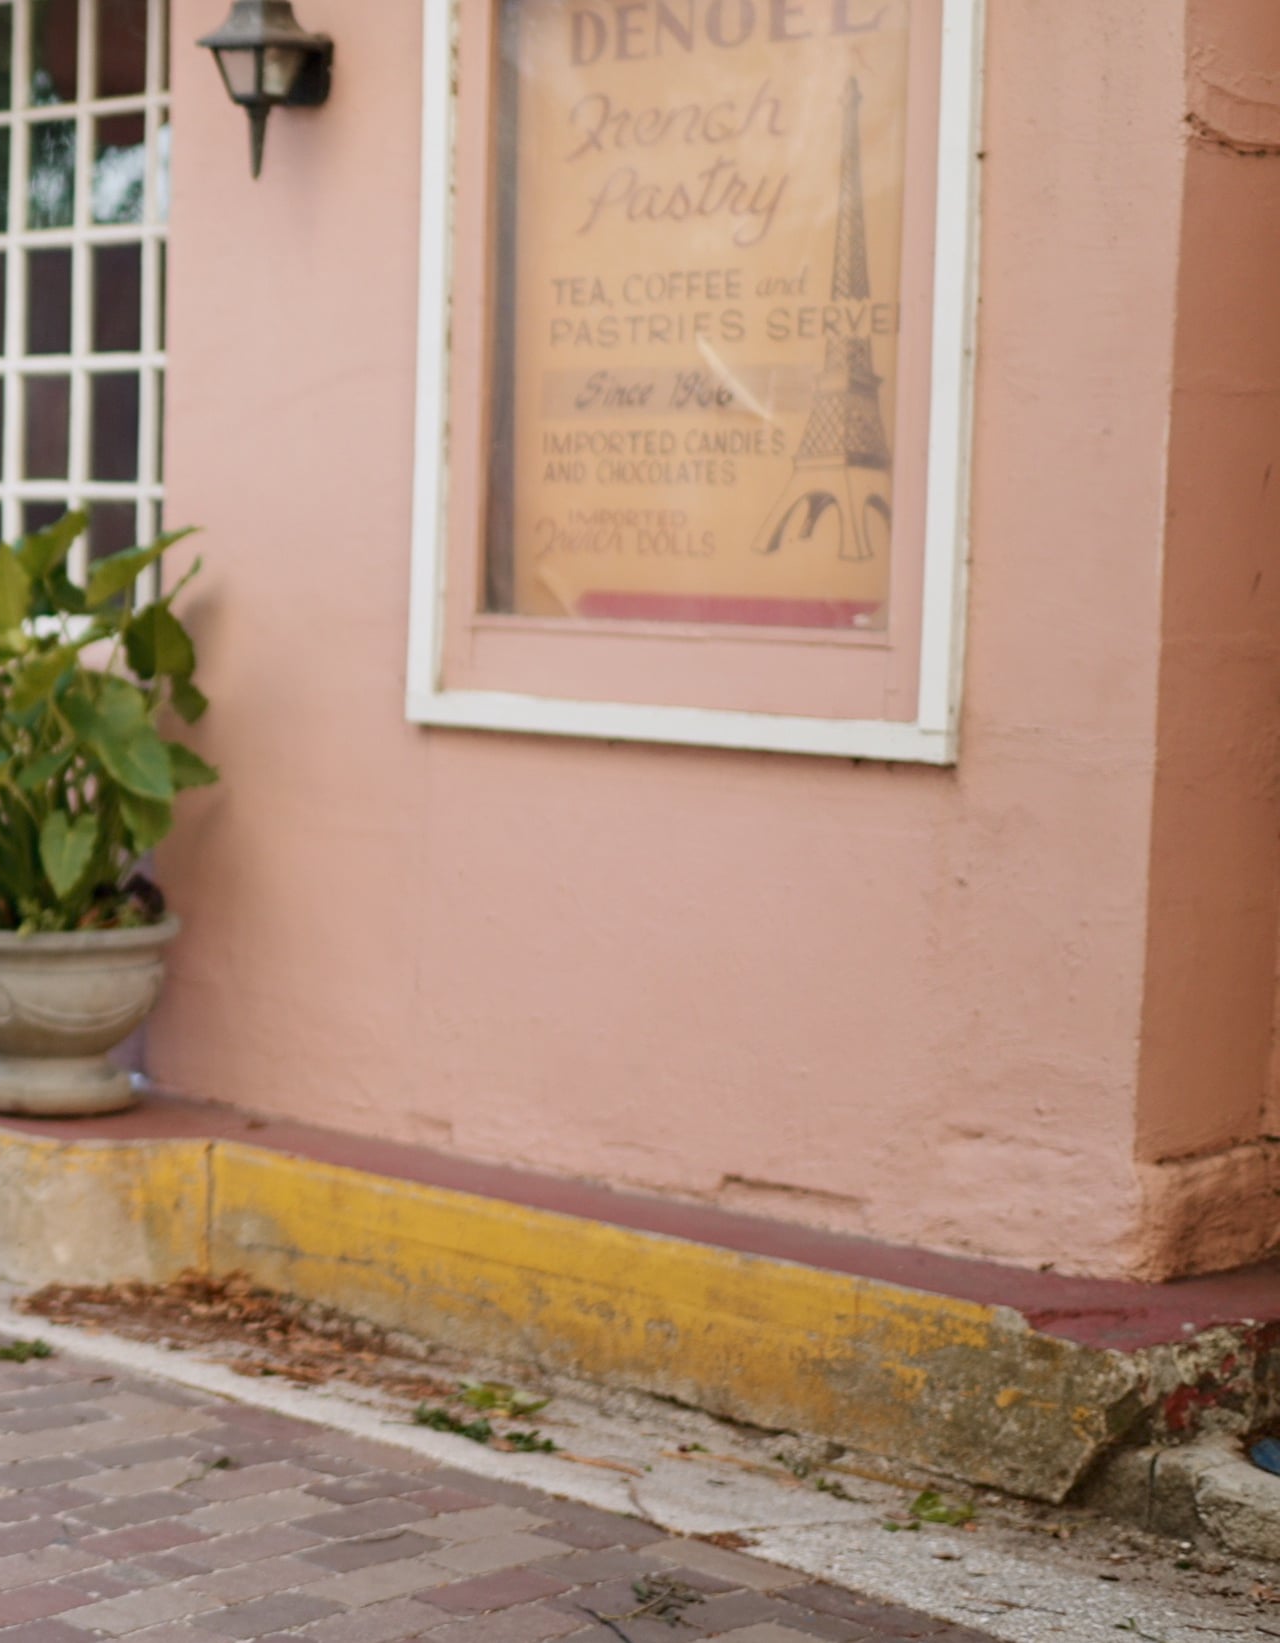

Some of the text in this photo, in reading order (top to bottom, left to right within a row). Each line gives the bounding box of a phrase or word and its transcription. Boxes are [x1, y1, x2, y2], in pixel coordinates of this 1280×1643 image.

[570, 0, 890, 67] DENOEL
[565, 77, 787, 163] French
[576, 154, 790, 248] Pastry
[549, 265, 809, 310] TEA, COFFEE and
[548, 302, 900, 348] PASTRIES SERVE
[574, 369, 655, 409] Since
[543, 428, 786, 458] IMPORTED CANDIES
[543, 458, 737, 486] AND CHOCOLATES
[569, 508, 688, 530] IMPORTED
[636, 528, 717, 559] DOLLS
